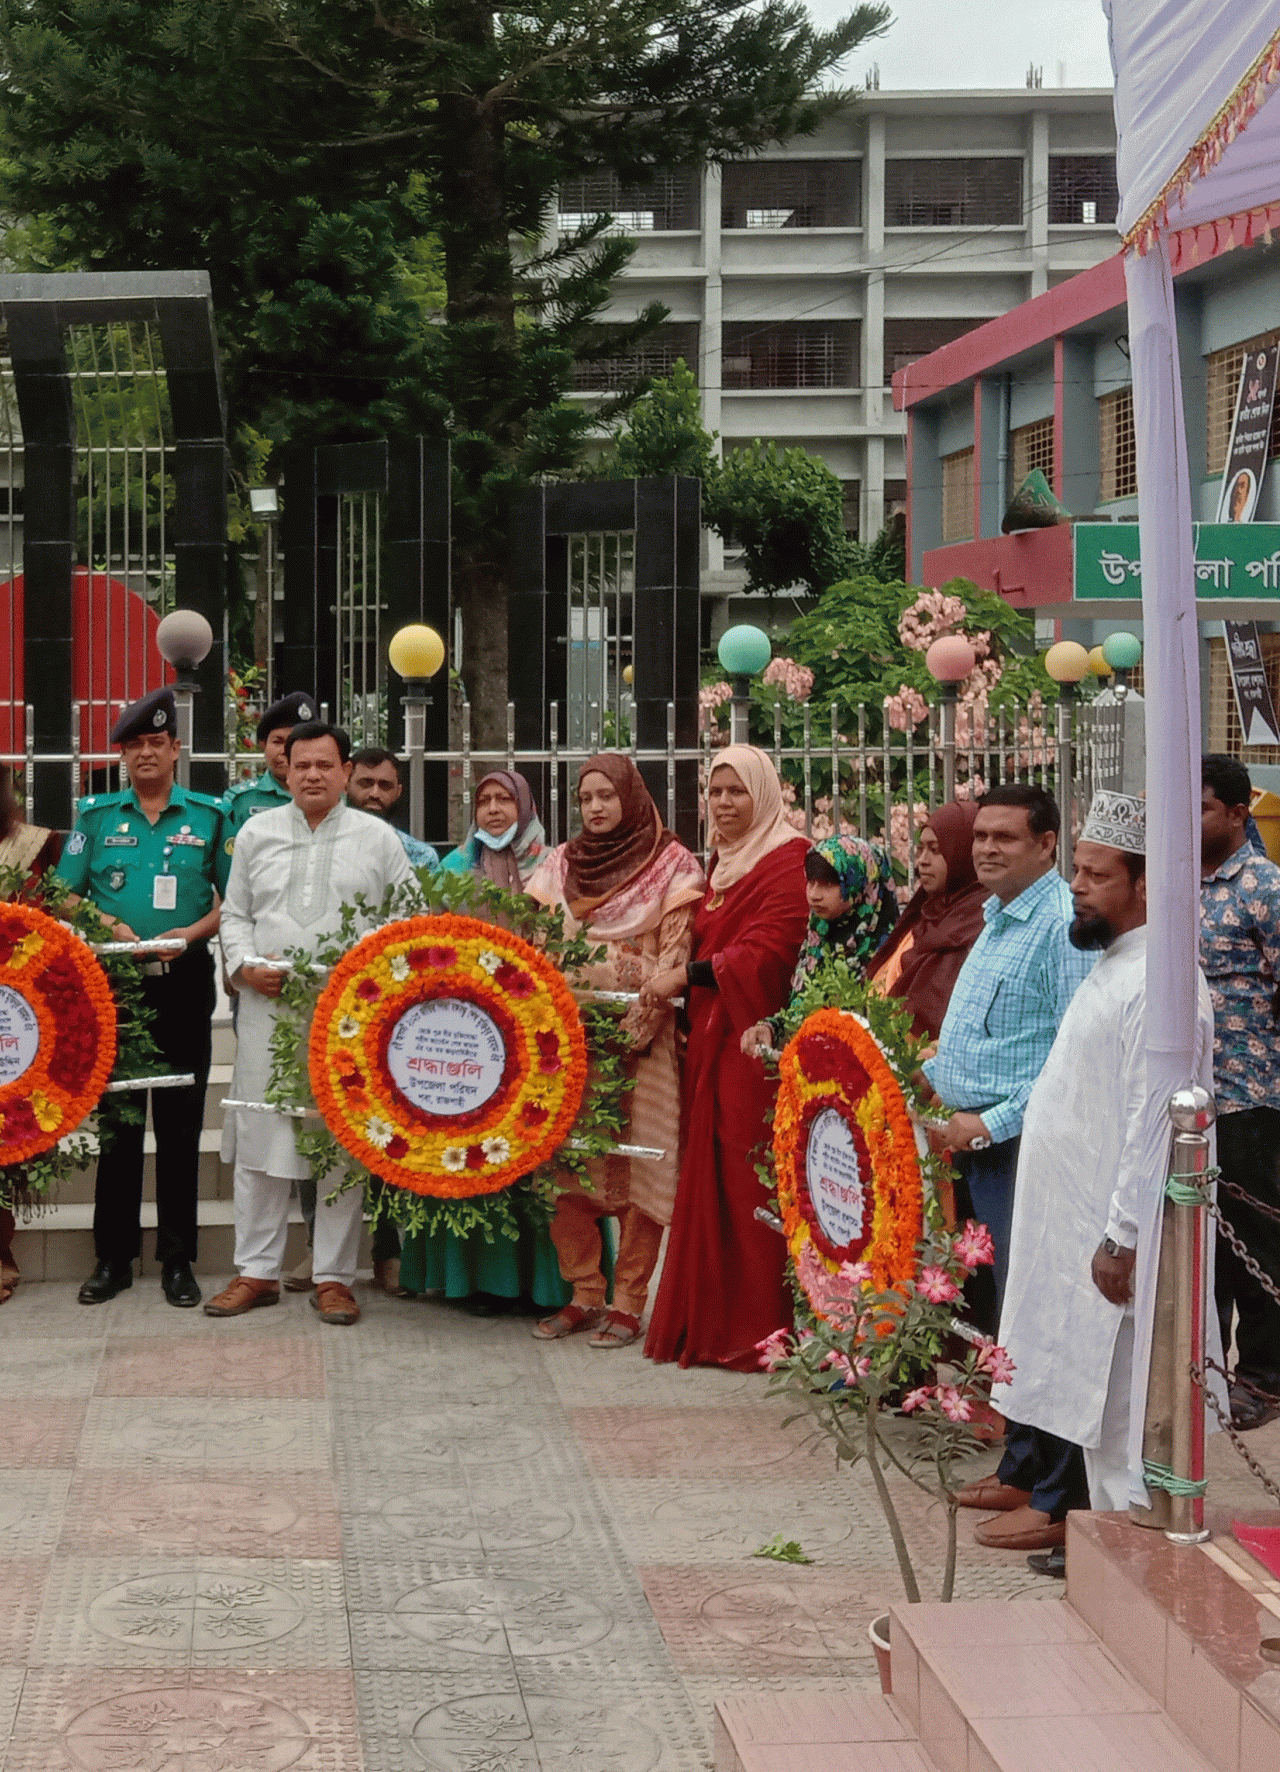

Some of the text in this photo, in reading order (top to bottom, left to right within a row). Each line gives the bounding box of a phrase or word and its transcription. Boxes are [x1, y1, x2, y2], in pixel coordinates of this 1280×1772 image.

[406, 1059, 484, 1079] শ্রদ্ধাঞ্জলি
[409, 1076, 478, 1096] উপজেলা পরিষদ
